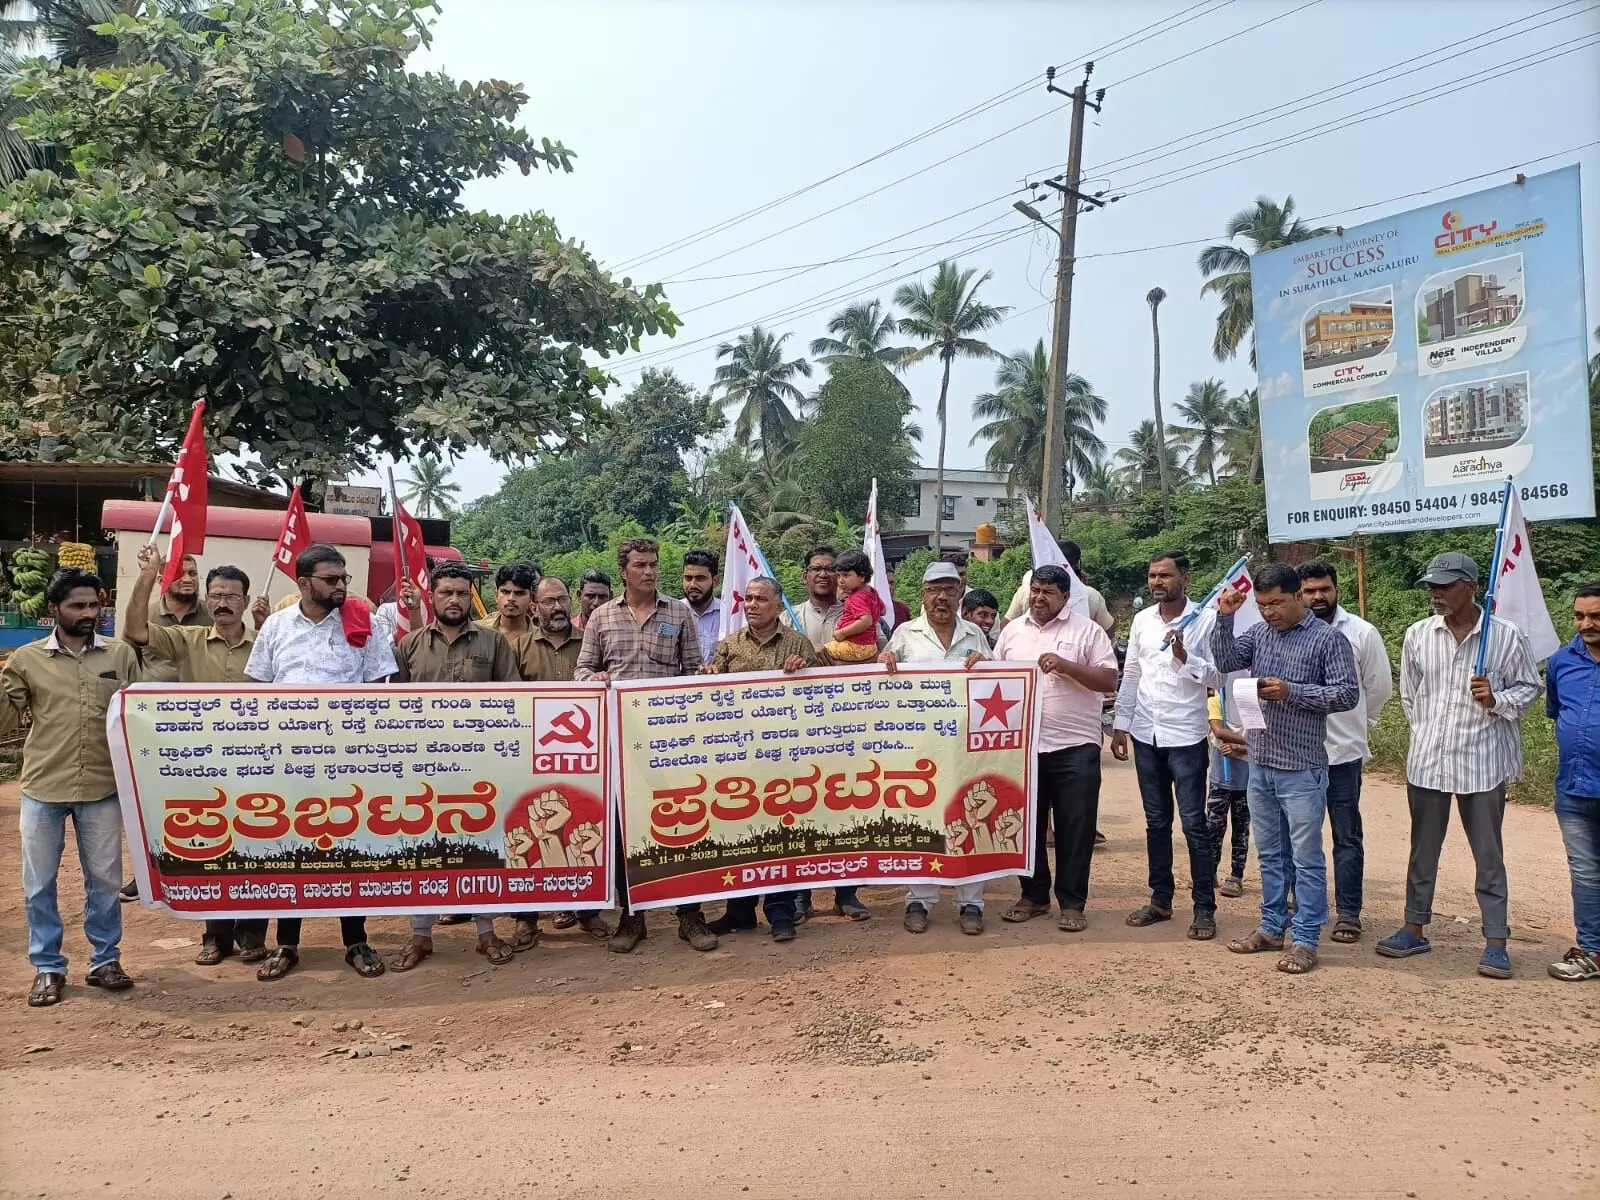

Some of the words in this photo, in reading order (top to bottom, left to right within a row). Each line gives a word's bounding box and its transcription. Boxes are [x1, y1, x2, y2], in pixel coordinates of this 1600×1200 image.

[1434, 220, 1497, 248] CITY
[1506, 224, 1544, 240] DEVELOPERS
[1522, 232, 1544, 240] TRUST
[1293, 250, 1325, 264] EMBARK
[1326, 246, 1344, 256] THE
[1345, 232, 1385, 252] JOURNEY
[1386, 230, 1400, 238] OF
[1307, 244, 1385, 278] SUCCESS
[1280, 290, 1290, 298] IN
[1354, 255, 1420, 279] MANGALURU
[1430, 348, 1455, 360] Nest
[1462, 336, 1516, 352] INDEPENDENT
[1475, 346, 1503, 356] VILLAS
[1312, 376, 1355, 388] COMMERCIAL
[1356, 370, 1388, 380] COMPLEX
[1334, 365, 1364, 377] CITY
[1453, 456, 1502, 474] Aaradhya
[1288, 512, 1310, 524] FOR
[1314, 505, 1368, 522] ENQUIRY:
[1372, 500, 1411, 516] 98450
[1416, 496, 1458, 512] 54404
[1470, 490, 1505, 506] 9845
[1521, 483, 1568, 500] 84568
[1358, 512, 1480, 529] www.citybuildersanddevelopers.com
[39, 618, 53, 626] JOY
[648, 691, 703, 710] ಸುರತ್ಕಲ್
[710, 690, 735, 706] ರೈಲ್ವೆ
[742, 686, 786, 700] ಸೇತುವೆ
[792, 682, 844, 700] ಅಕ್ಕಪಕ್ಕದ
[852, 680, 872, 696] ರಸ್ತೆ
[878, 679, 913, 692] ಗುಂಡಿ
[156, 698, 221, 717] ಸುರತ್ಕಲ್
[230, 698, 259, 716] ರೈಲ್ವೆ
[267, 697, 320, 712] ಸೇತುವೆ
[328, 697, 390, 716] ಅಕ್ಕಪಕ್ಕದ
[399, 696, 424, 714] ರಸ್ತೆ
[432, 697, 472, 710] ಗುಂಡಿ
[647, 714, 688, 726] ವಾಹನ
[696, 710, 744, 722] ಸಂಚಾರ
[751, 705, 798, 720] ಯೋಗ್ಯ
[804, 702, 825, 718] ರಸ್ತೆ
[832, 700, 890, 712] ನಿರ್ಮಿಸಲು
[155, 720, 204, 732] ವಾಹನ
[212, 720, 270, 732] ಸಂಚಾರ
[278, 718, 334, 736] ಯೋಗ್ಯ
[342, 718, 366, 734] ರಸ್ತೆ
[374, 718, 444, 730] ನಿರ್ಮಿಸಲು
[650, 734, 696, 752] ಟ್ರಾಫಿಕ್
[702, 730, 755, 747] ಸಮಸ್ಯೆಗೆ
[761, 728, 800, 740] ಕಾರಣ
[806, 722, 867, 738] ಆಗುತ್ತಿರುವ
[874, 720, 926, 732] ಕೊಂಕಣ
[934, 720, 958, 736] ರೈಲ್ವೆ
[158, 744, 213, 760] ಟ್ರಾಫಿಕ್
[222, 743, 282, 760] ಸಮಸ್ಯೆಗೆ
[291, 744, 336, 756] ಕಾರಣ
[344, 742, 418, 758] ಆಗುತ್ತಿರುವ
[426, 741, 486, 753] ಕೊಂಕಣ
[494, 740, 520, 757] ರೈಲ್ವೆ
[970, 732, 1020, 750] DYFI
[536, 754, 598, 771] CITU
[649, 754, 708, 768] ರೋರೋ
[715, 750, 748, 764] ಘಟಕ
[754, 746, 782, 761] ಶೀಘ್ರ
[788, 740, 856, 762] ಸ್ಥಳಾಂತರಕ್ಕೆ
[159, 765, 228, 778] ರೋರೋ
[236, 764, 275, 778] ಘಟಕ
[284, 762, 316, 778] ಶೀಘ್ರ
[324, 761, 404, 780] ಸ್ಥಳಾಂತರಕ್ಕೆ
[650, 758, 937, 848] ಪ್ರತಿಭಟನೆ
[163, 781, 498, 861] ಪ್ರತಿಭಟನೆ
[658, 850, 718, 864] 11-10-2023
[835, 835, 870, 848] ಸುರತ್ಕಲ್
[874, 835, 890, 848] ರೈಲ್ವೆ
[226, 862, 296, 870] 11-10-2023
[351, 859, 392, 870] ಸುರತ್ಕಲ್
[398, 858, 416, 870] ರೈಲ್ವೆ
[742, 864, 787, 883] DYFI
[796, 856, 868, 877] ಸುರತ್ಕಲ್
[878, 856, 923, 874] ಘಟಕ
[303, 879, 352, 898] ಚಾಲಕರ
[359, 876, 412, 896] ಮಾಲಕರ
[419, 876, 449, 897] ಸಂಘ
[456, 874, 502, 898] (CITU)
